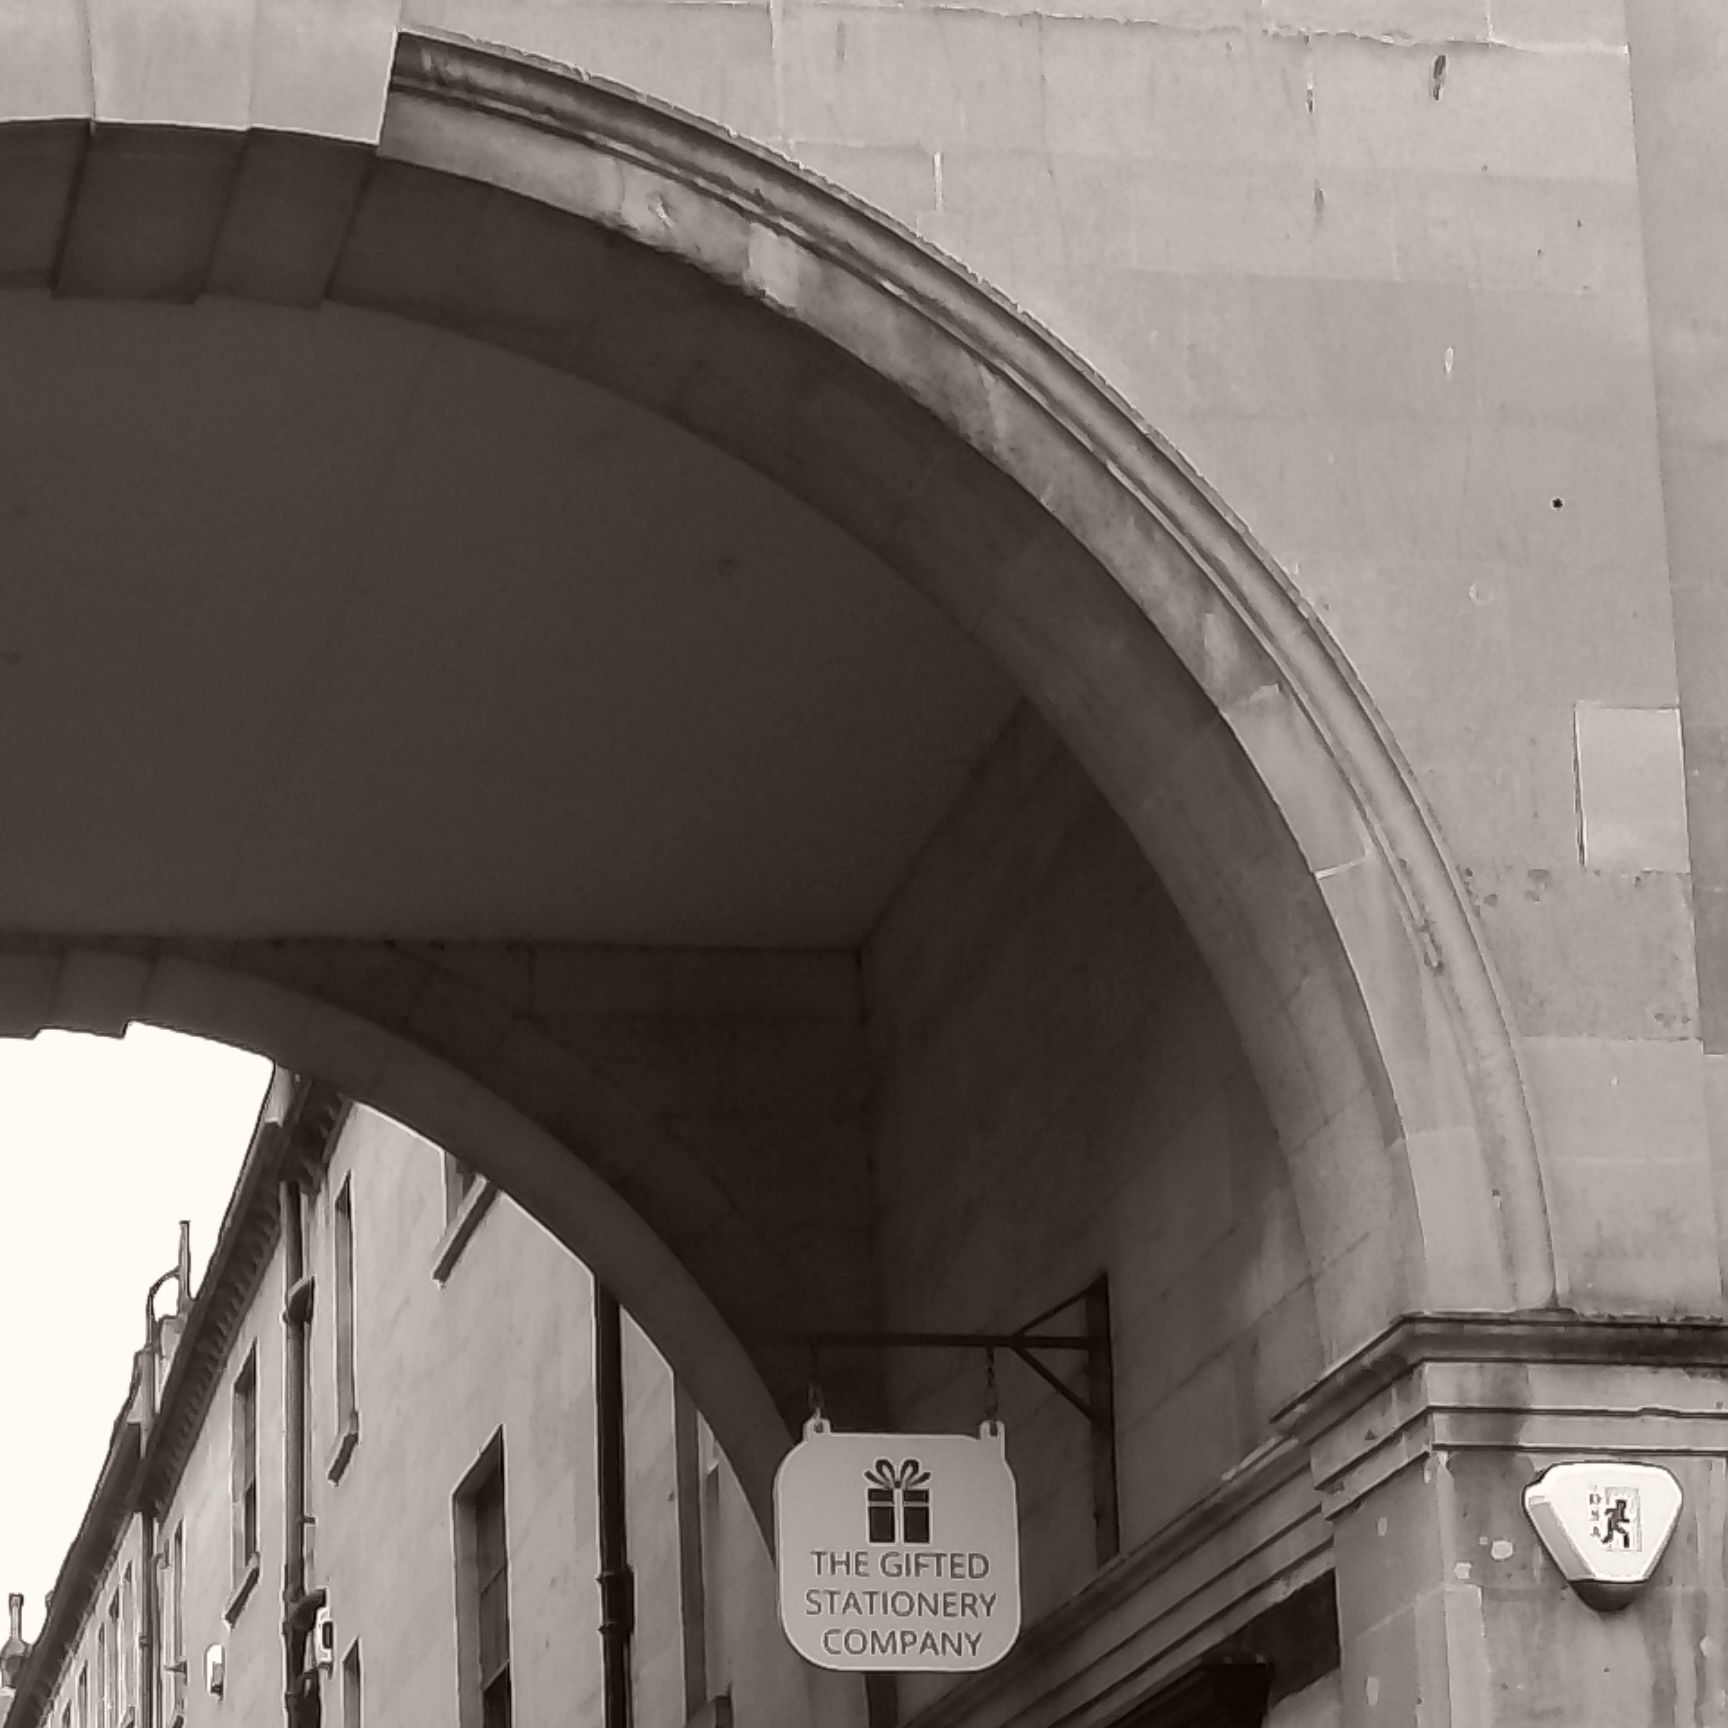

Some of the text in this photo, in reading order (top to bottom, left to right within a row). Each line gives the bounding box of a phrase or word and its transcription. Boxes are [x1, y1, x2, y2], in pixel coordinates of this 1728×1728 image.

[810, 1551, 990, 1579] THE GIFTED
[805, 1589, 997, 1618] STATIONERY
[823, 1629, 983, 1656] COMPANY
